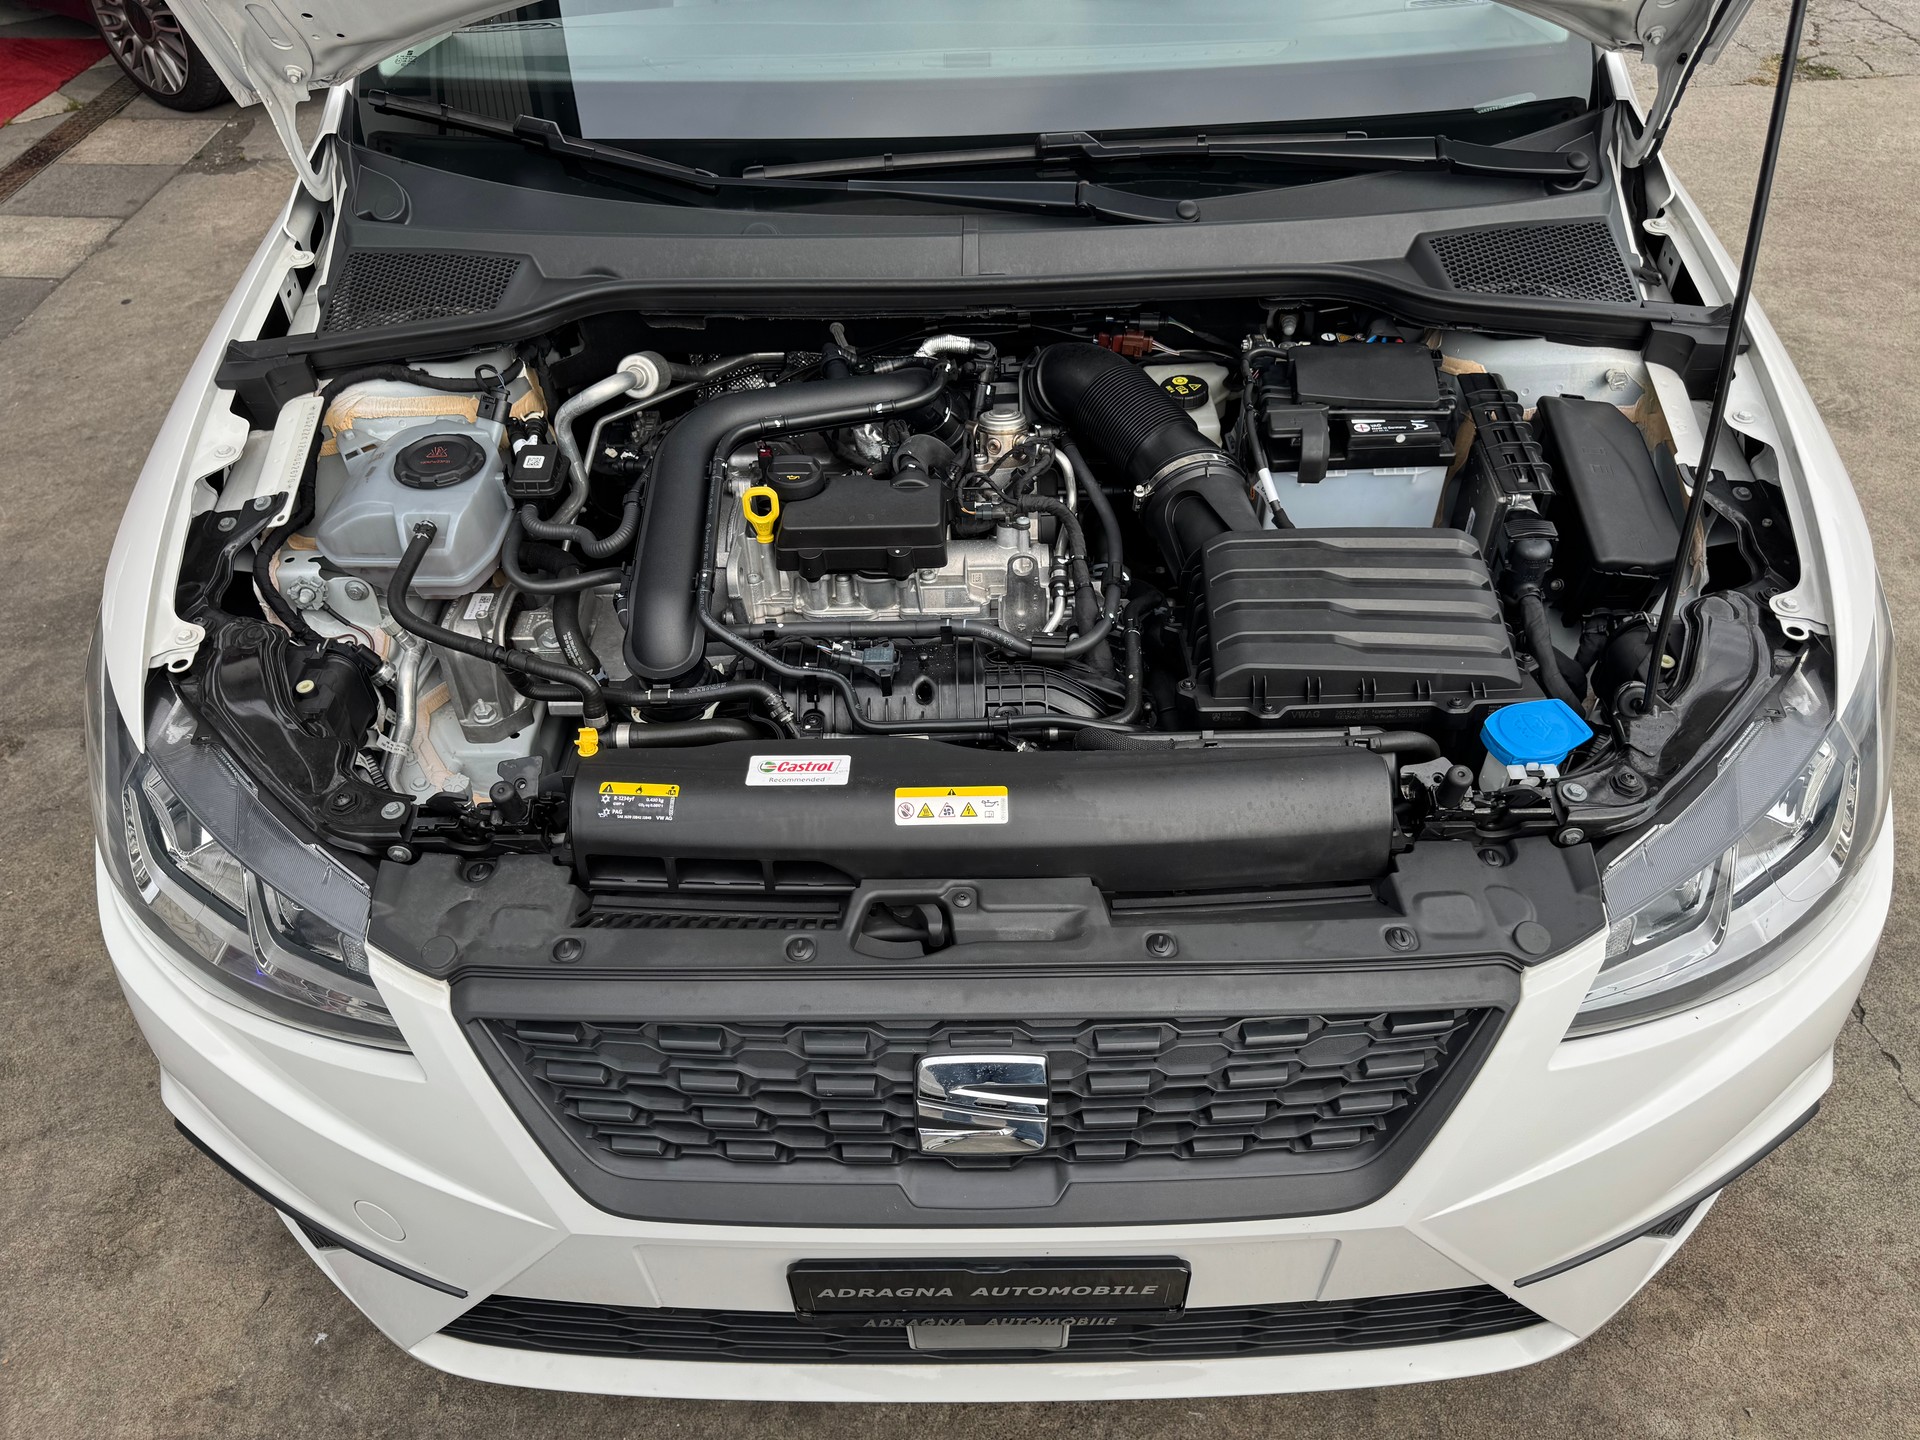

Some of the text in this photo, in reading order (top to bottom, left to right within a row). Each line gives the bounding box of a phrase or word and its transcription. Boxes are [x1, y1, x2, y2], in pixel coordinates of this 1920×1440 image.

[777, 762, 834, 772] Castrol
[817, 1285, 1159, 1298] ADRAGNA AUTOMOBILE
[863, 1316, 1118, 1328] ADRAGNA AUTOMOBILE
